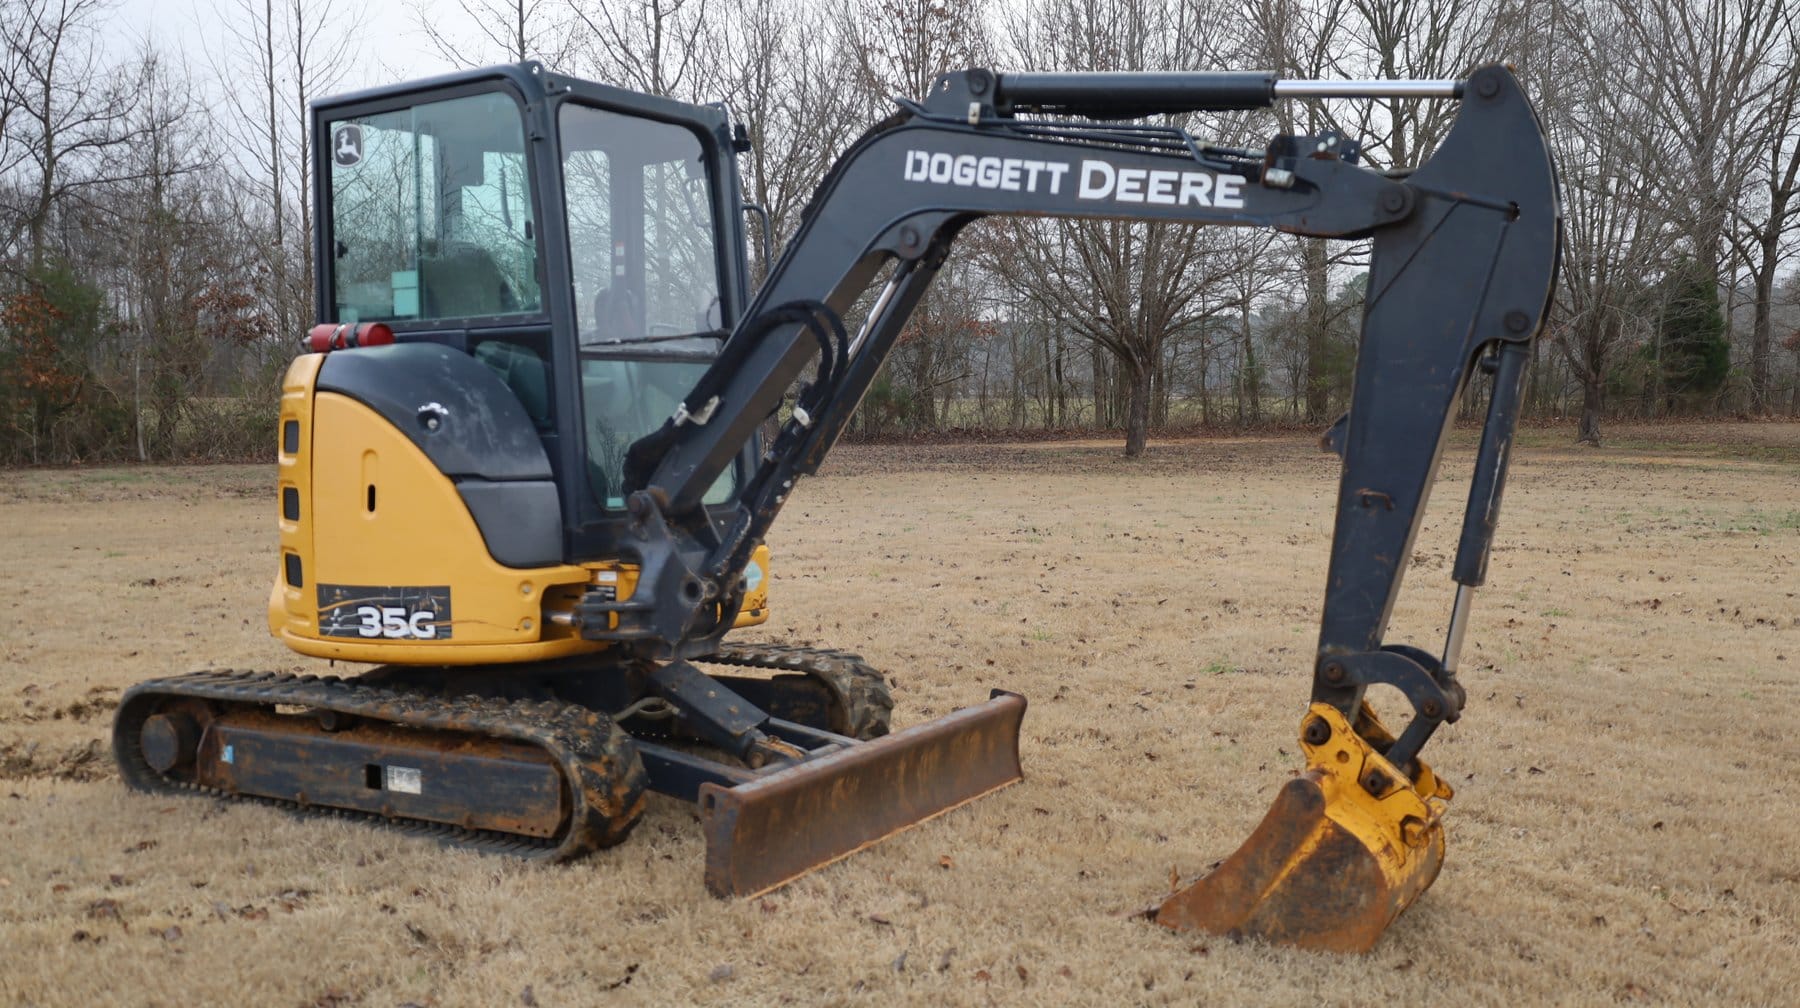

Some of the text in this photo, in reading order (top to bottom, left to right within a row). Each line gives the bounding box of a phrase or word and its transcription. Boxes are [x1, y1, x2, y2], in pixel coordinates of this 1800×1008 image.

[904, 150, 1247, 208] DOGGETT DEERE
[357, 606, 436, 638] 35G
